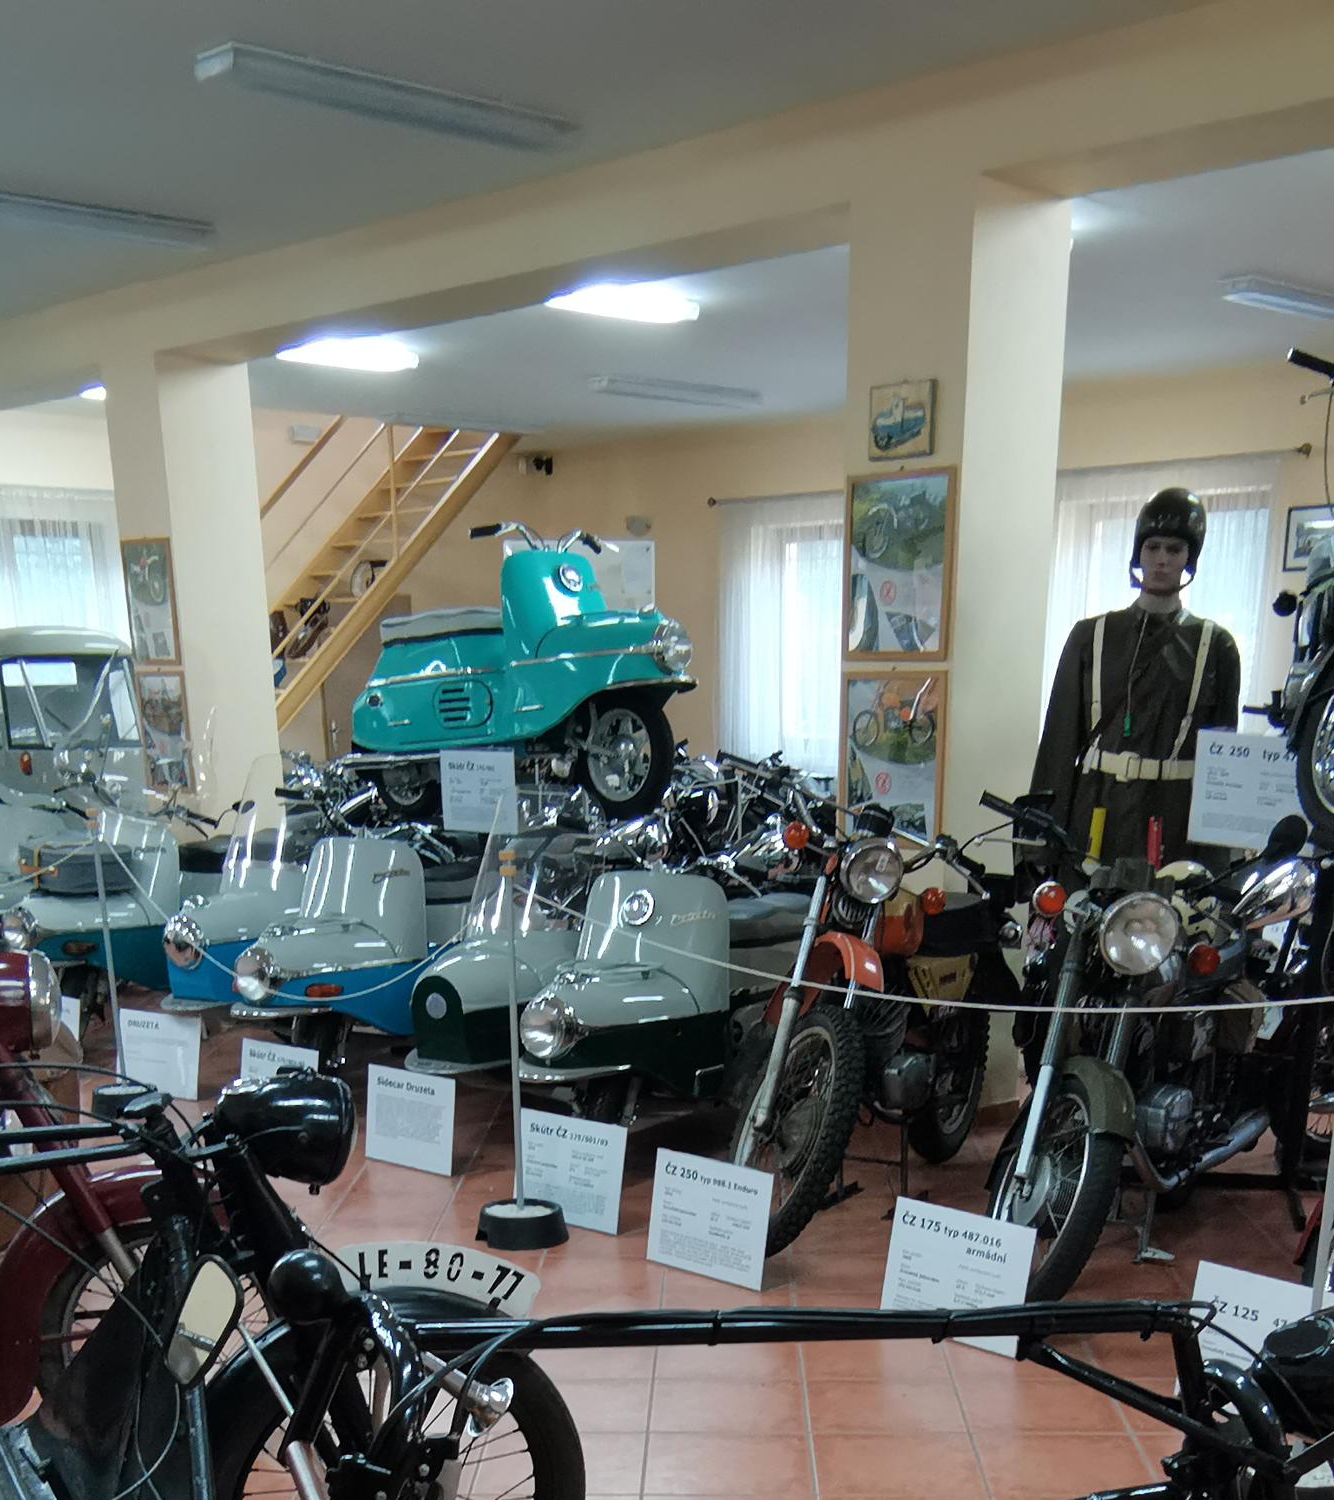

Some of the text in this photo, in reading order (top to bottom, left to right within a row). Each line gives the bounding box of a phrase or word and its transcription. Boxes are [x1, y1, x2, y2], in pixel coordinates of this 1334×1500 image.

[1229, 745, 1250, 758] 250
[1262, 749, 1280, 763] typ
[377, 1075, 404, 1089] Sidecar
[529, 1122, 554, 1136] Skútr
[556, 1124, 568, 1139] ČZ
[665, 1160, 678, 1177] ČZ
[680, 1167, 699, 1181] 250
[700, 1175, 713, 1186] typ
[733, 1182, 759, 1195] Enduro
[902, 1210, 1002, 1249] ČZ 175 typ 487.016
[965, 1247, 1008, 1264] armádní
[1232, 1304, 1260, 1321] 125
